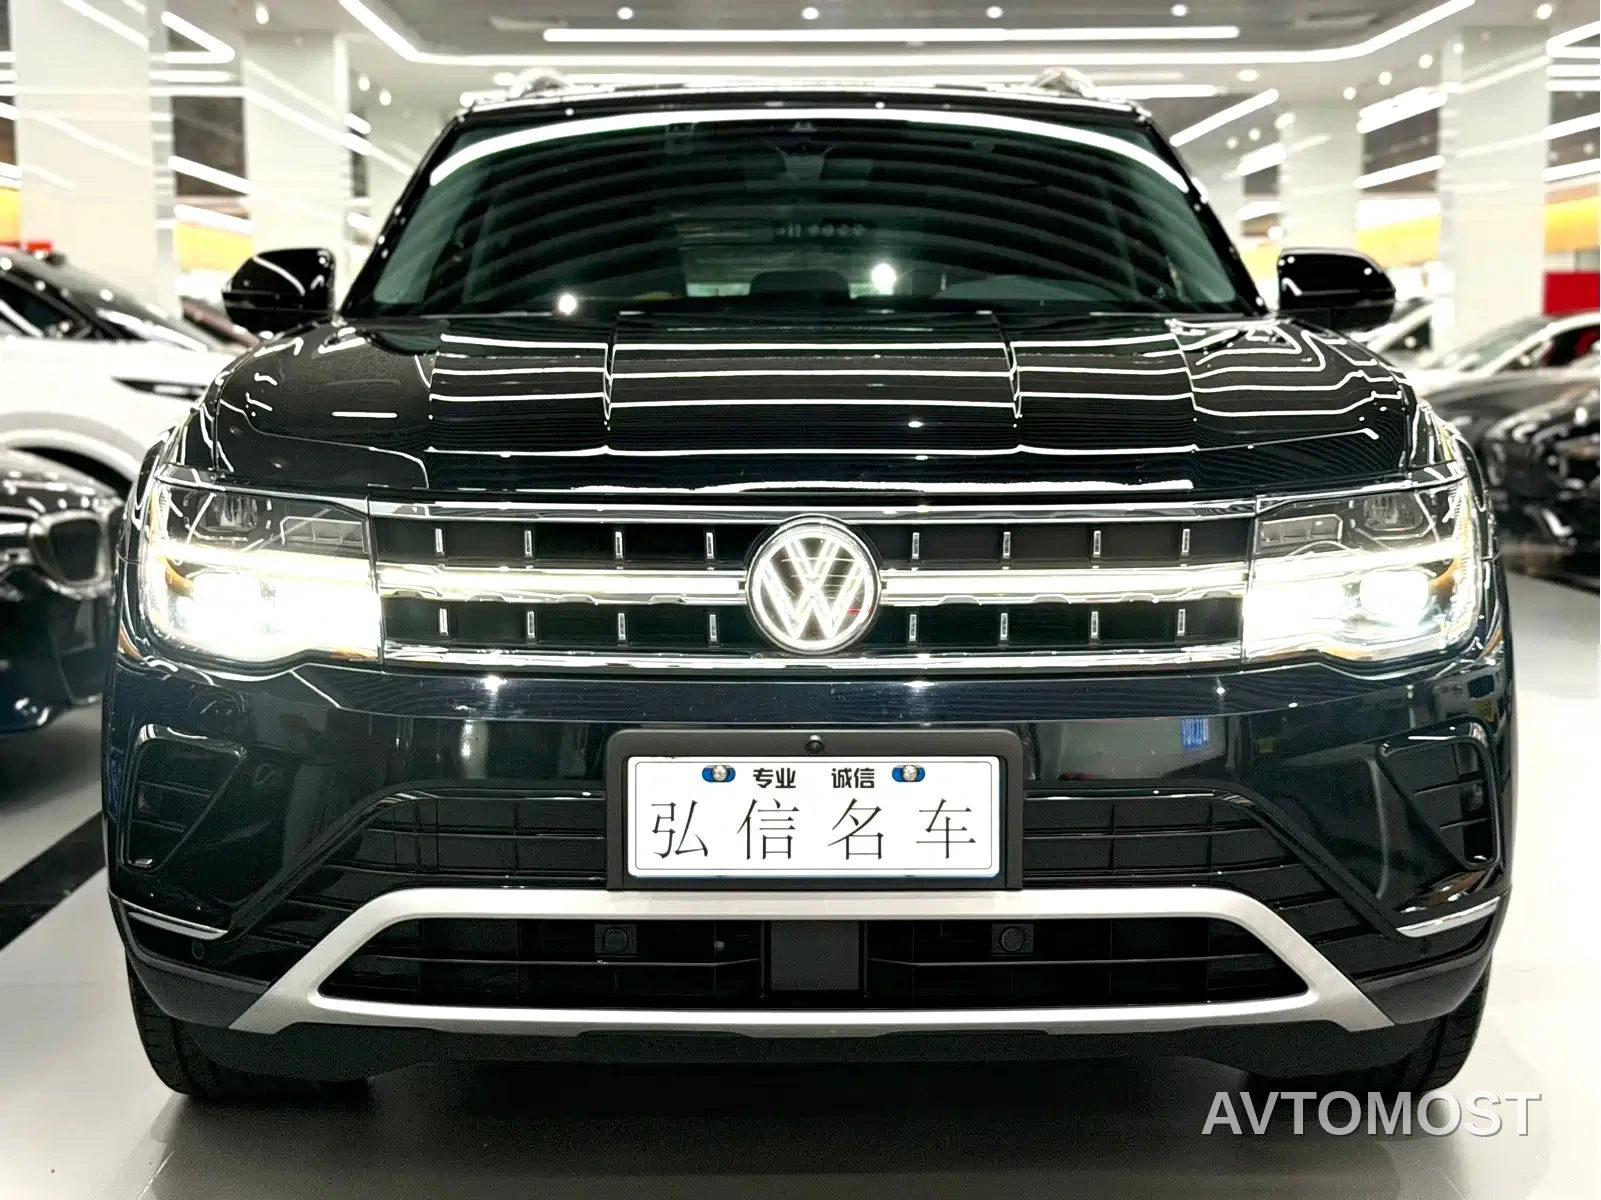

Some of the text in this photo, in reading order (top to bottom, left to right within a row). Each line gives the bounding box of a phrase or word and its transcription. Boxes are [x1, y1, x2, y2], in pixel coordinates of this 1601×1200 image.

[757, 531, 870, 645] VW
[752, 767, 876, 789] 专业 诚信
[651, 798, 976, 860] 弘信名车
